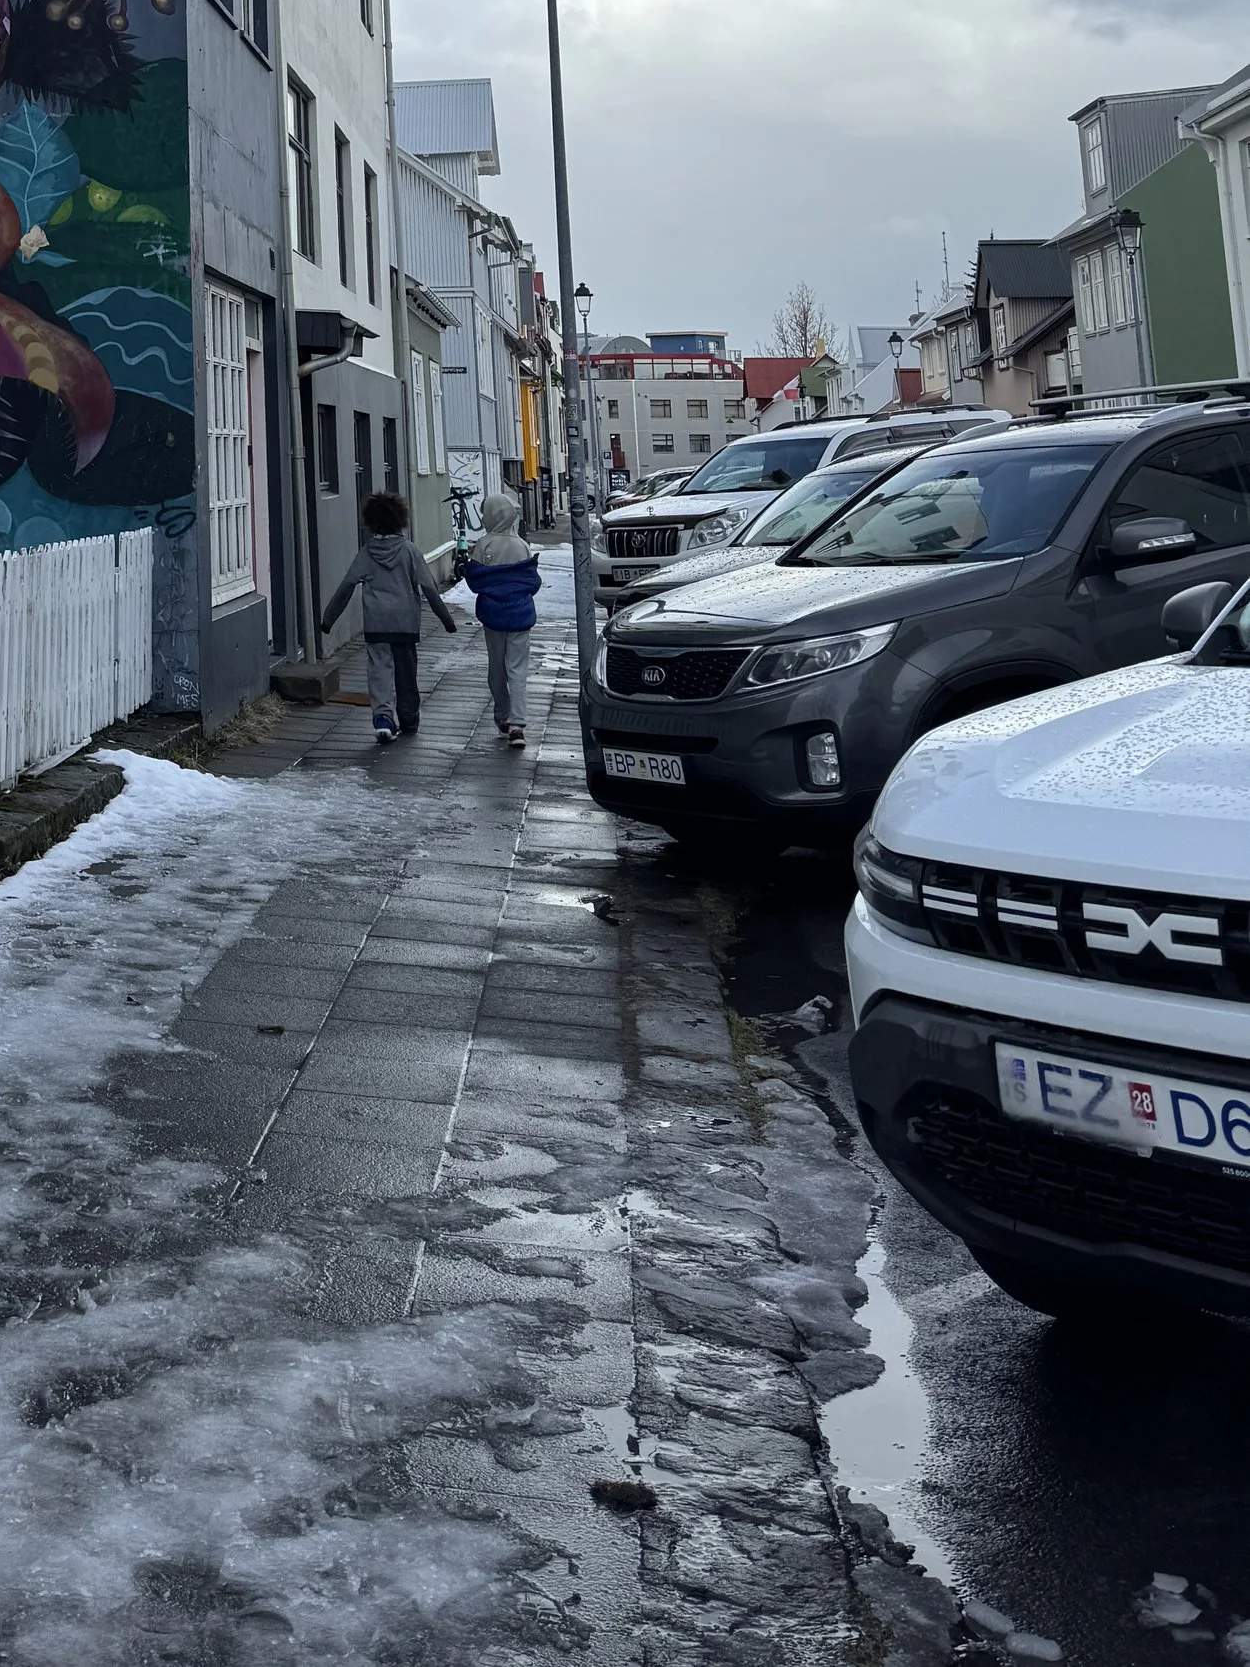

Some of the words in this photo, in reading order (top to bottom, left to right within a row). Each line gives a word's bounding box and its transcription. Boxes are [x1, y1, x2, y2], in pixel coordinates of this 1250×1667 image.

[644, 670, 660, 681] KIA
[614, 753, 636, 774] BP
[648, 757, 681, 780] R80
[1036, 1061, 1120, 1130] EZ
[1132, 1090, 1153, 1113] 28
